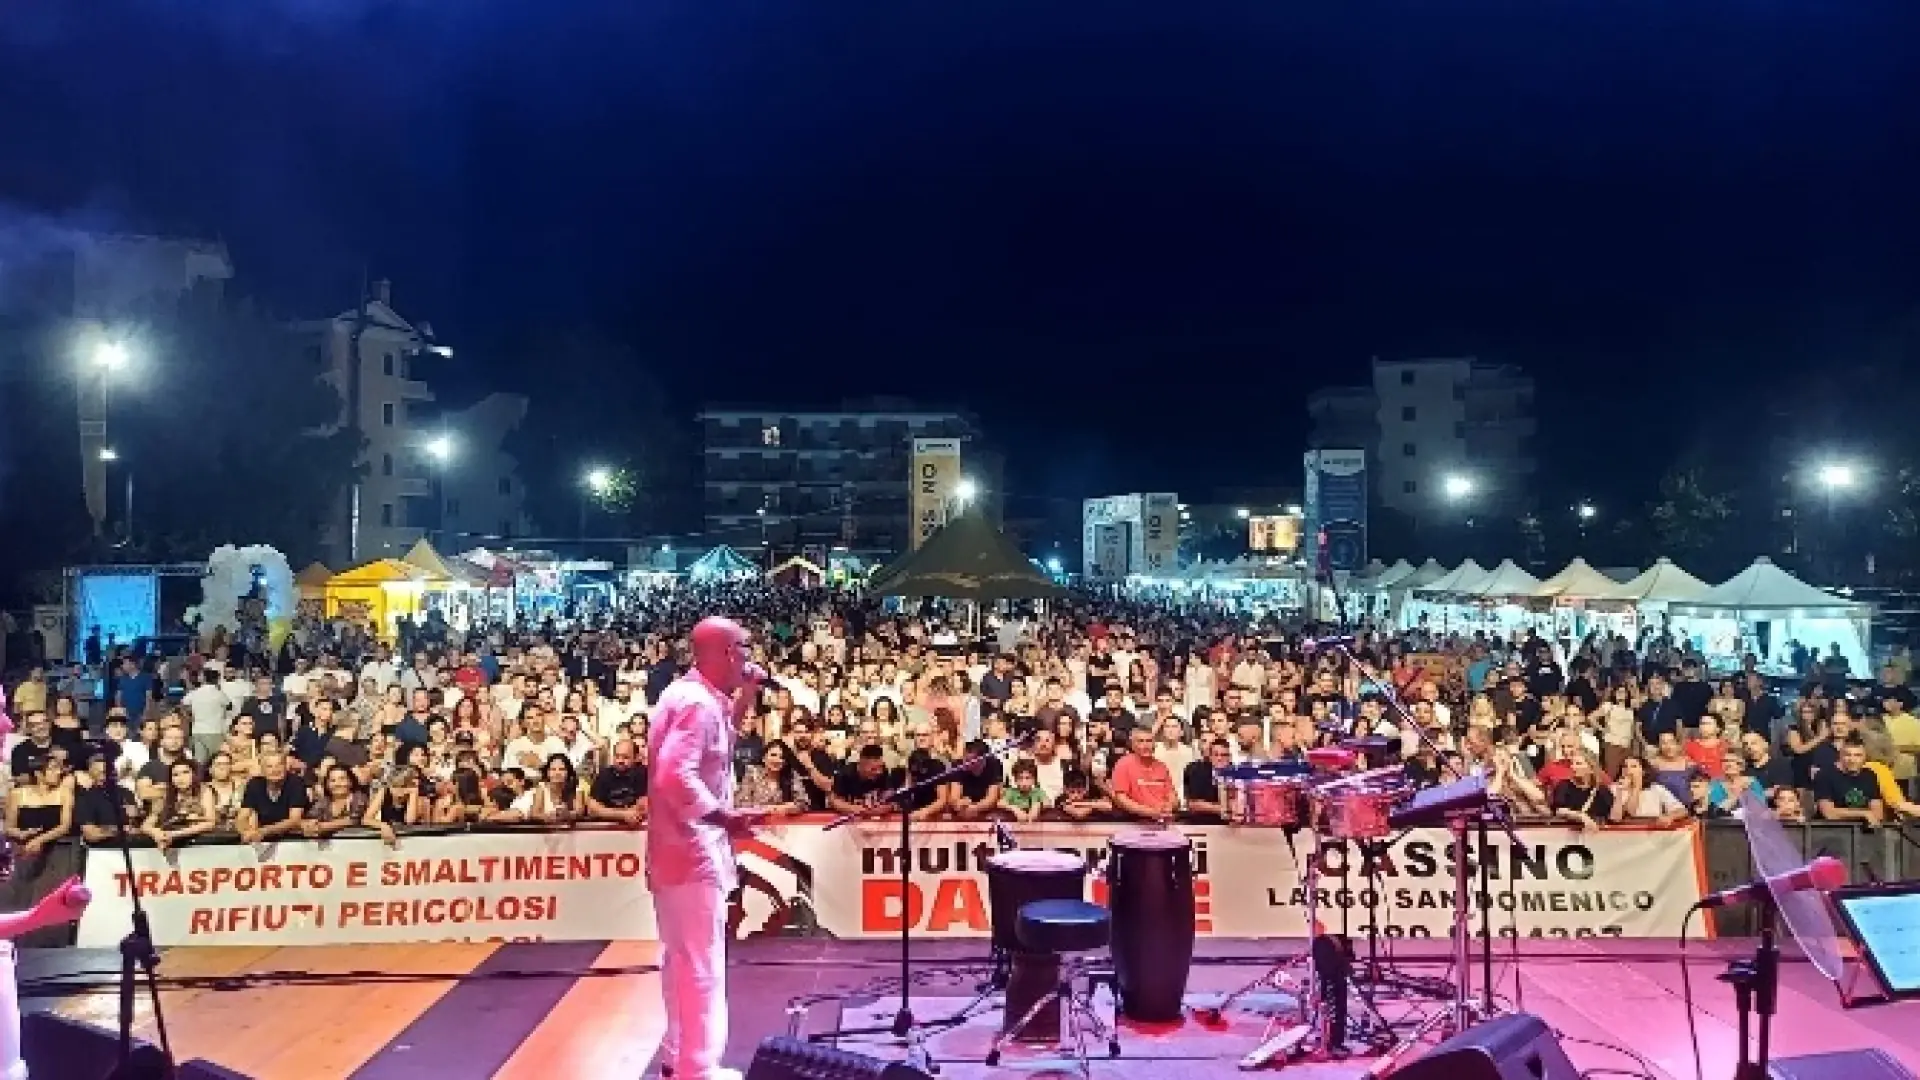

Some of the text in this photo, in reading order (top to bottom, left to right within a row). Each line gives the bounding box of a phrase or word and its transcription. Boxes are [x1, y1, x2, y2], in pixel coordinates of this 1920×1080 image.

[114, 852, 640, 897] TRASPORTO E SMALTIMENTO
[1319, 841, 1594, 880] CASSINO
[189, 896, 557, 935] RIFIUTI PERICOLOSI
[1267, 886, 1655, 912] LARGO SAN DOMENICO
